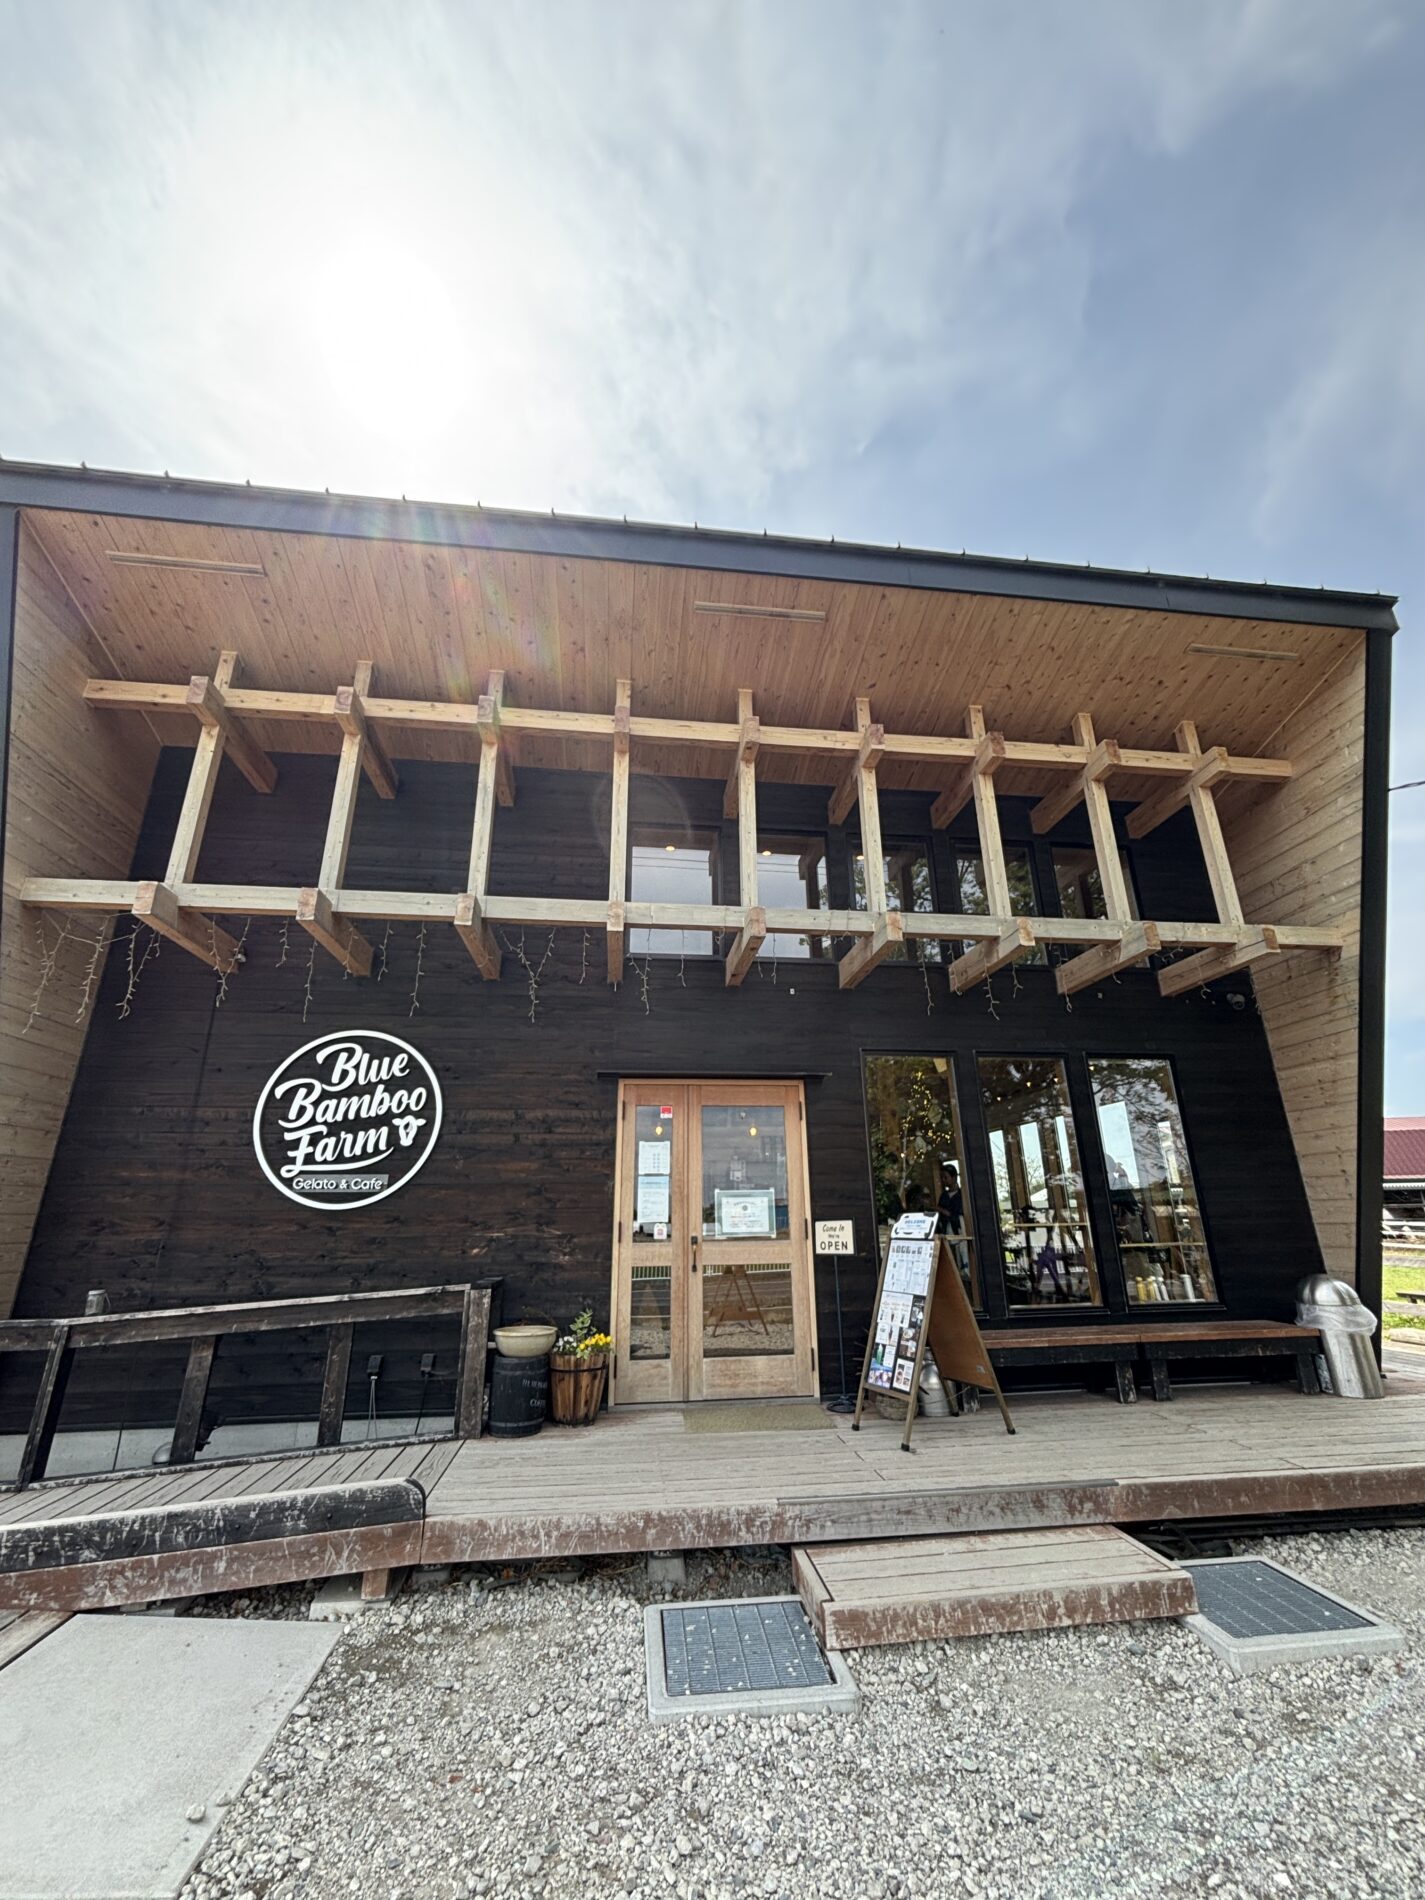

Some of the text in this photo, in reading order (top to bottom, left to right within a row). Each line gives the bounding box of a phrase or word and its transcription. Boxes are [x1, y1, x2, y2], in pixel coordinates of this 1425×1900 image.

[316, 1043, 410, 1092] Blue
[274, 1078, 427, 1128] Bamboo
[280, 1124, 394, 1178] Farm
[292, 1177, 337, 1189] Gelato
[339, 1179, 348, 1189] &
[822, 1224, 837, 1232] Come
[820, 1241, 848, 1250] OPEN
